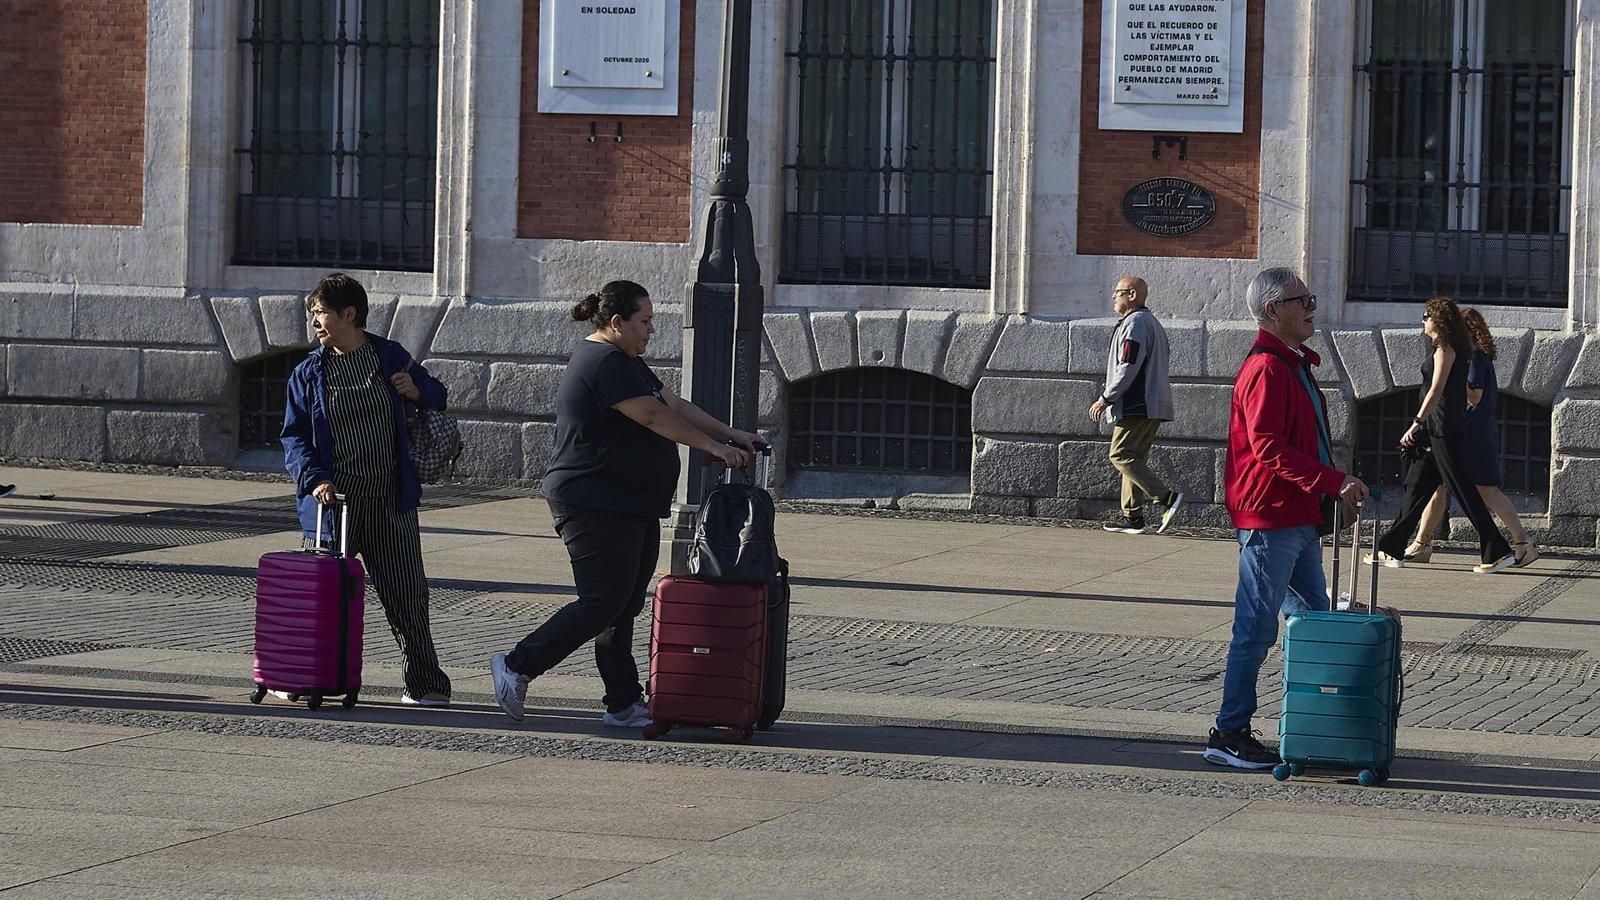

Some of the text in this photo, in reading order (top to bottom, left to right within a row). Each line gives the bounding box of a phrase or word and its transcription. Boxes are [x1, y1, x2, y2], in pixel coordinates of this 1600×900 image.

[581, 6, 636, 14] EN SOLEDAD
[1128, 4, 1217, 12] QUE LAS AYUDARON.
[1127, 21, 1218, 30] QUE EL RECUERDO DE
[1130, 30, 1214, 41] LAS VÍCTIMAS Y EL
[1149, 43, 1194, 51] EJEMPLAR
[603, 56, 633, 64] OCTUBRE
[1123, 54, 1221, 63] COMPORTAMIENTO DEL
[1130, 65, 1214, 74] PUEBLO DE MADRID
[1118, 75, 1225, 85] PERMANEZCAN SIEMPRE.
